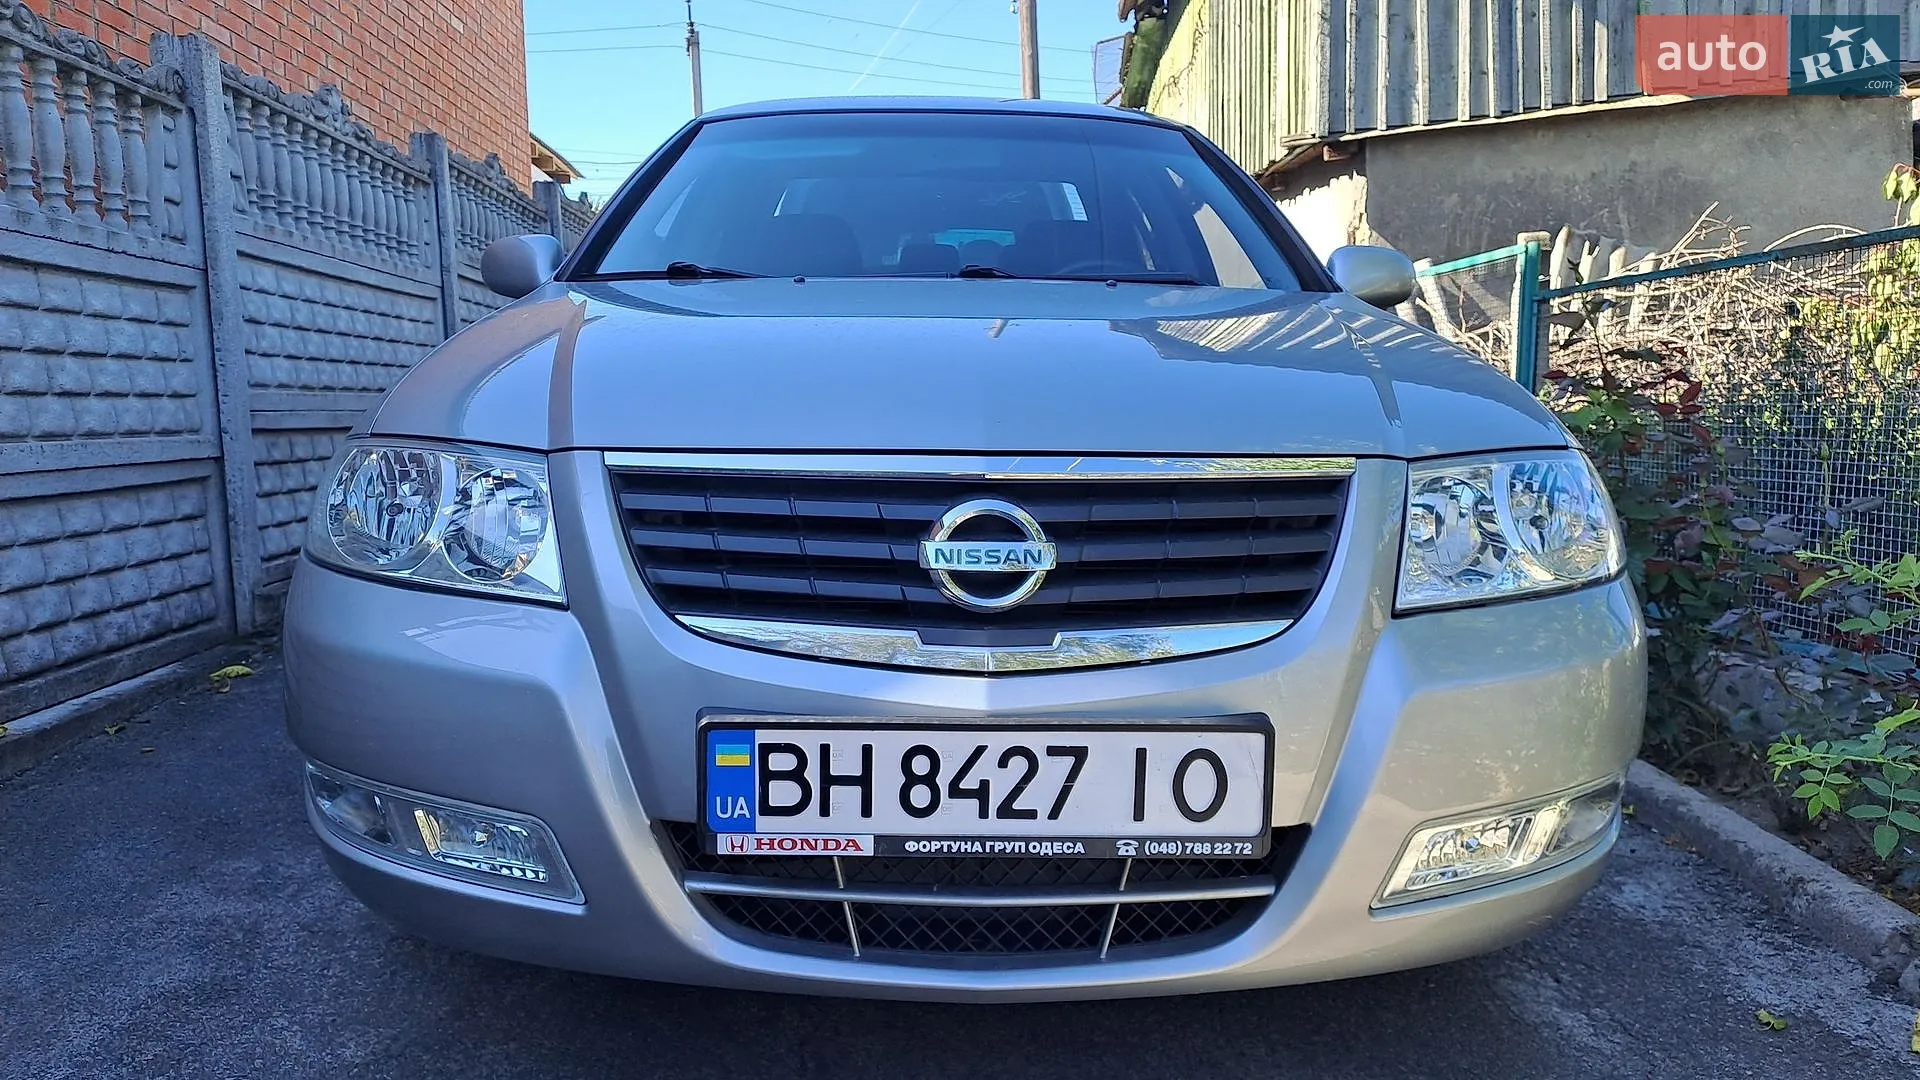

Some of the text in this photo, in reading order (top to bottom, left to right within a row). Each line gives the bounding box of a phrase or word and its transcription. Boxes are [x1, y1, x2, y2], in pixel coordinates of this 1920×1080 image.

[934, 548, 1042, 565] NISSAN
[757, 743, 873, 818] BH
[899, 744, 1089, 820] 8427
[716, 796, 751, 819] UA
[754, 837, 864, 852] HONDA
[904, 840, 1085, 856] ФОРТУНА ГРУП ОДЕСА
[1144, 840, 1182, 855] (048)
[1213, 843, 1231, 855] 22
[1234, 843, 1252, 855] 72
